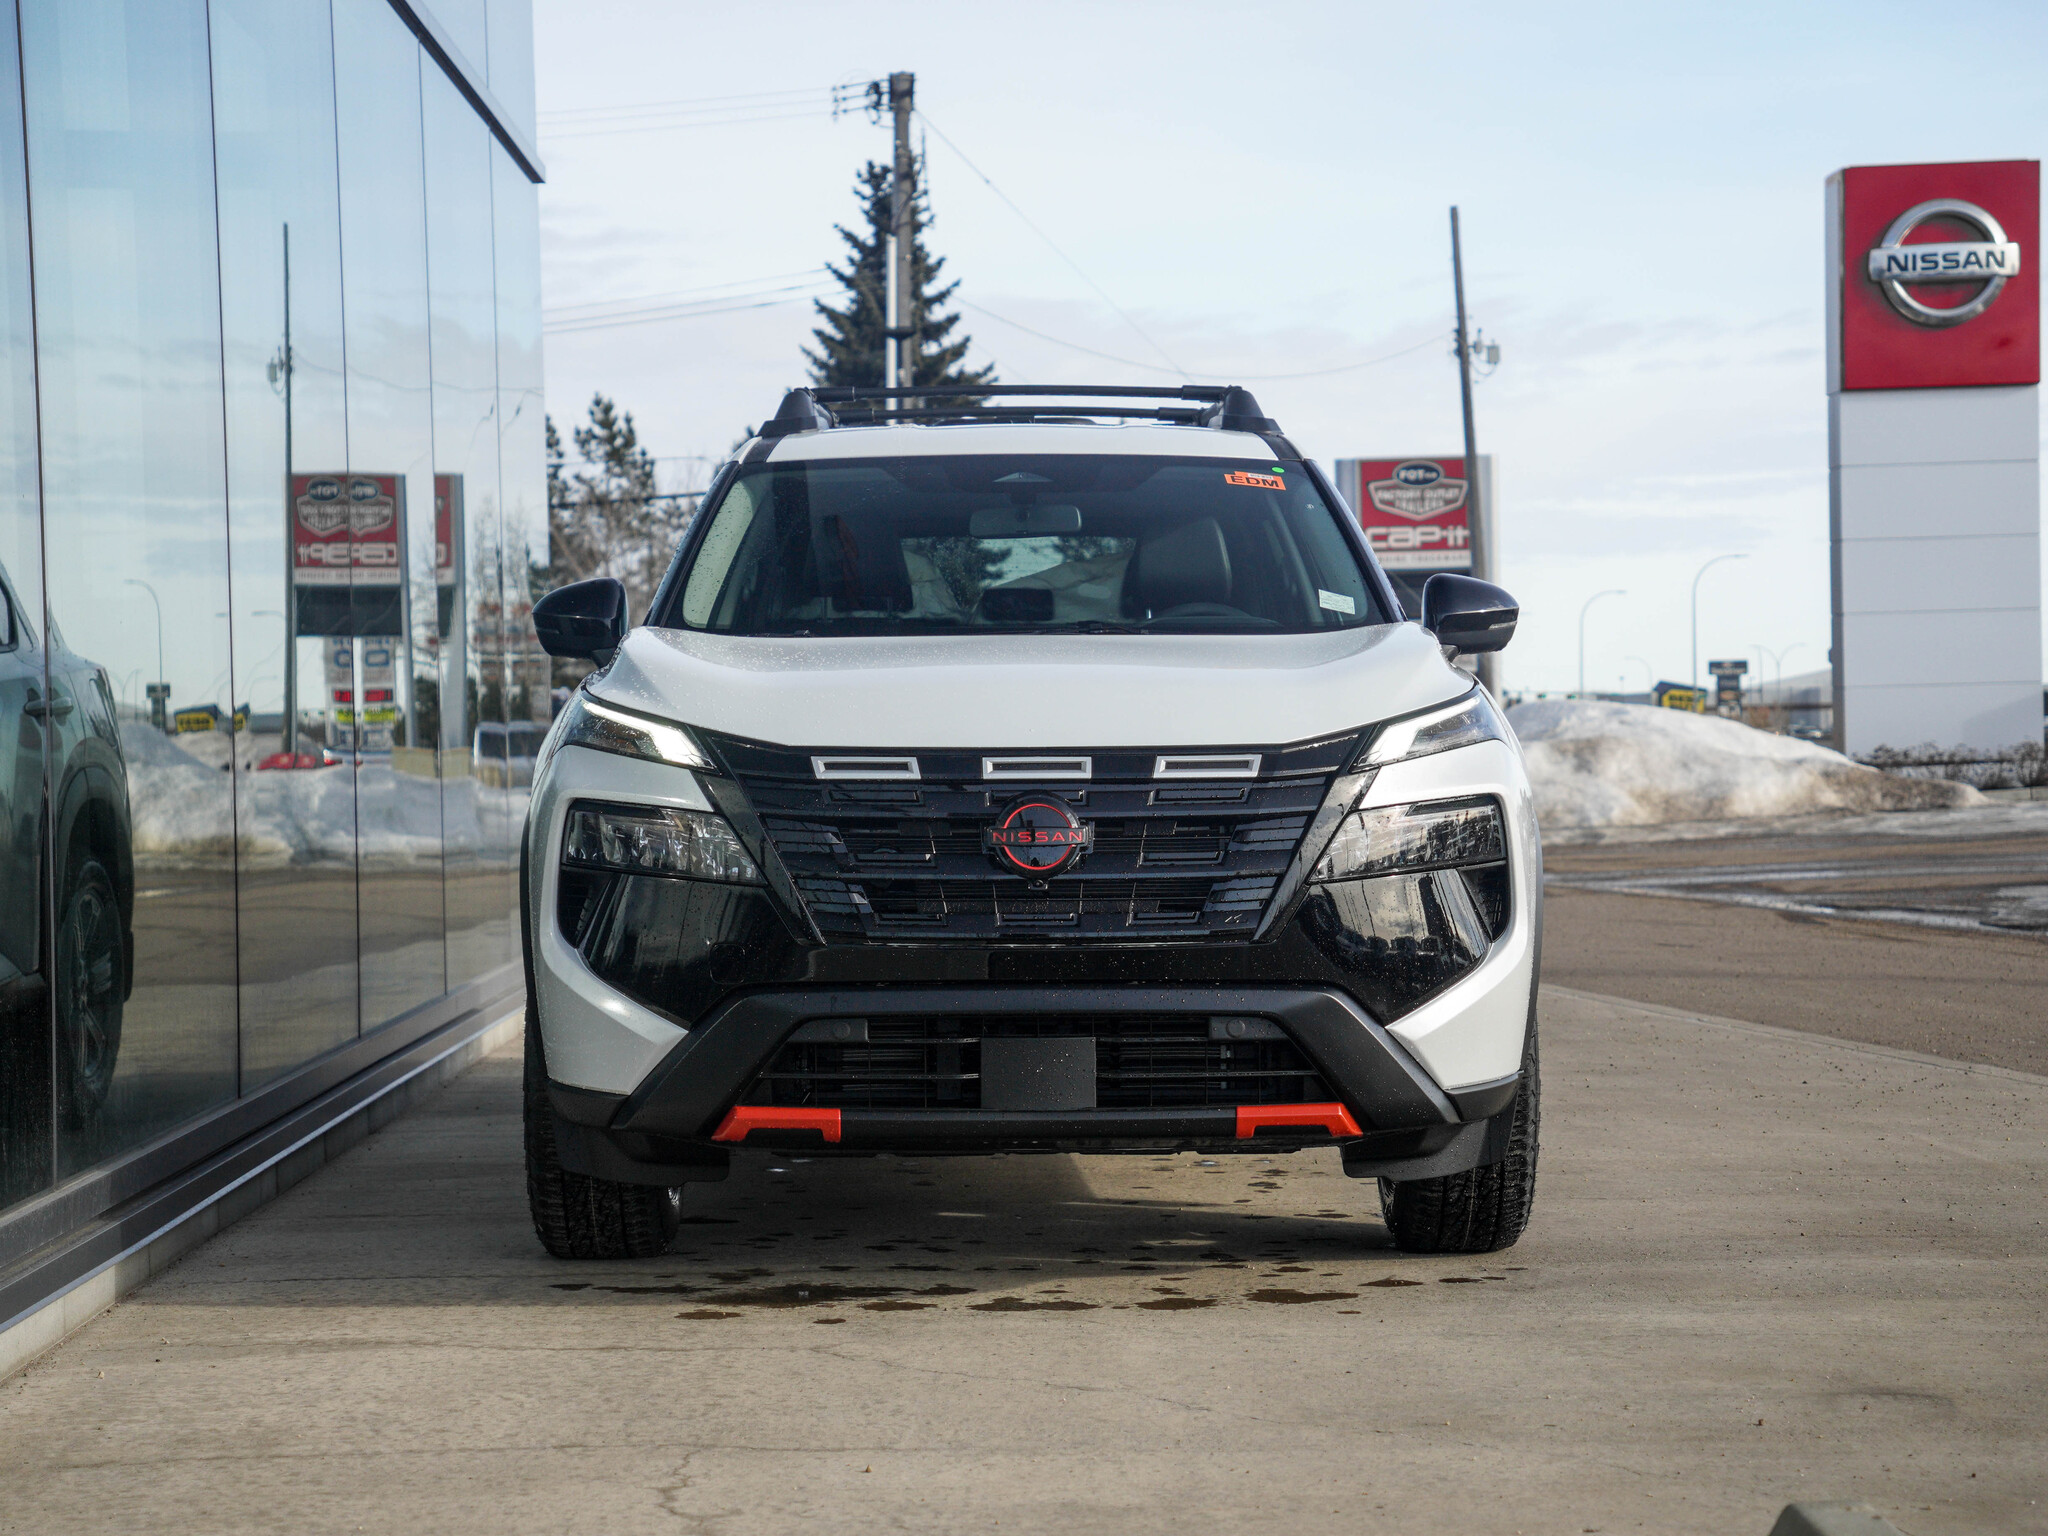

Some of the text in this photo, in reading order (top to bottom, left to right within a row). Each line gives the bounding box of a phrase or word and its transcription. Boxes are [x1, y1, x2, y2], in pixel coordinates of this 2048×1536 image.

[1886, 251, 2006, 272] NISSAN
[1230, 475, 1280, 488] EDM
[992, 831, 1083, 843] NISSAN
